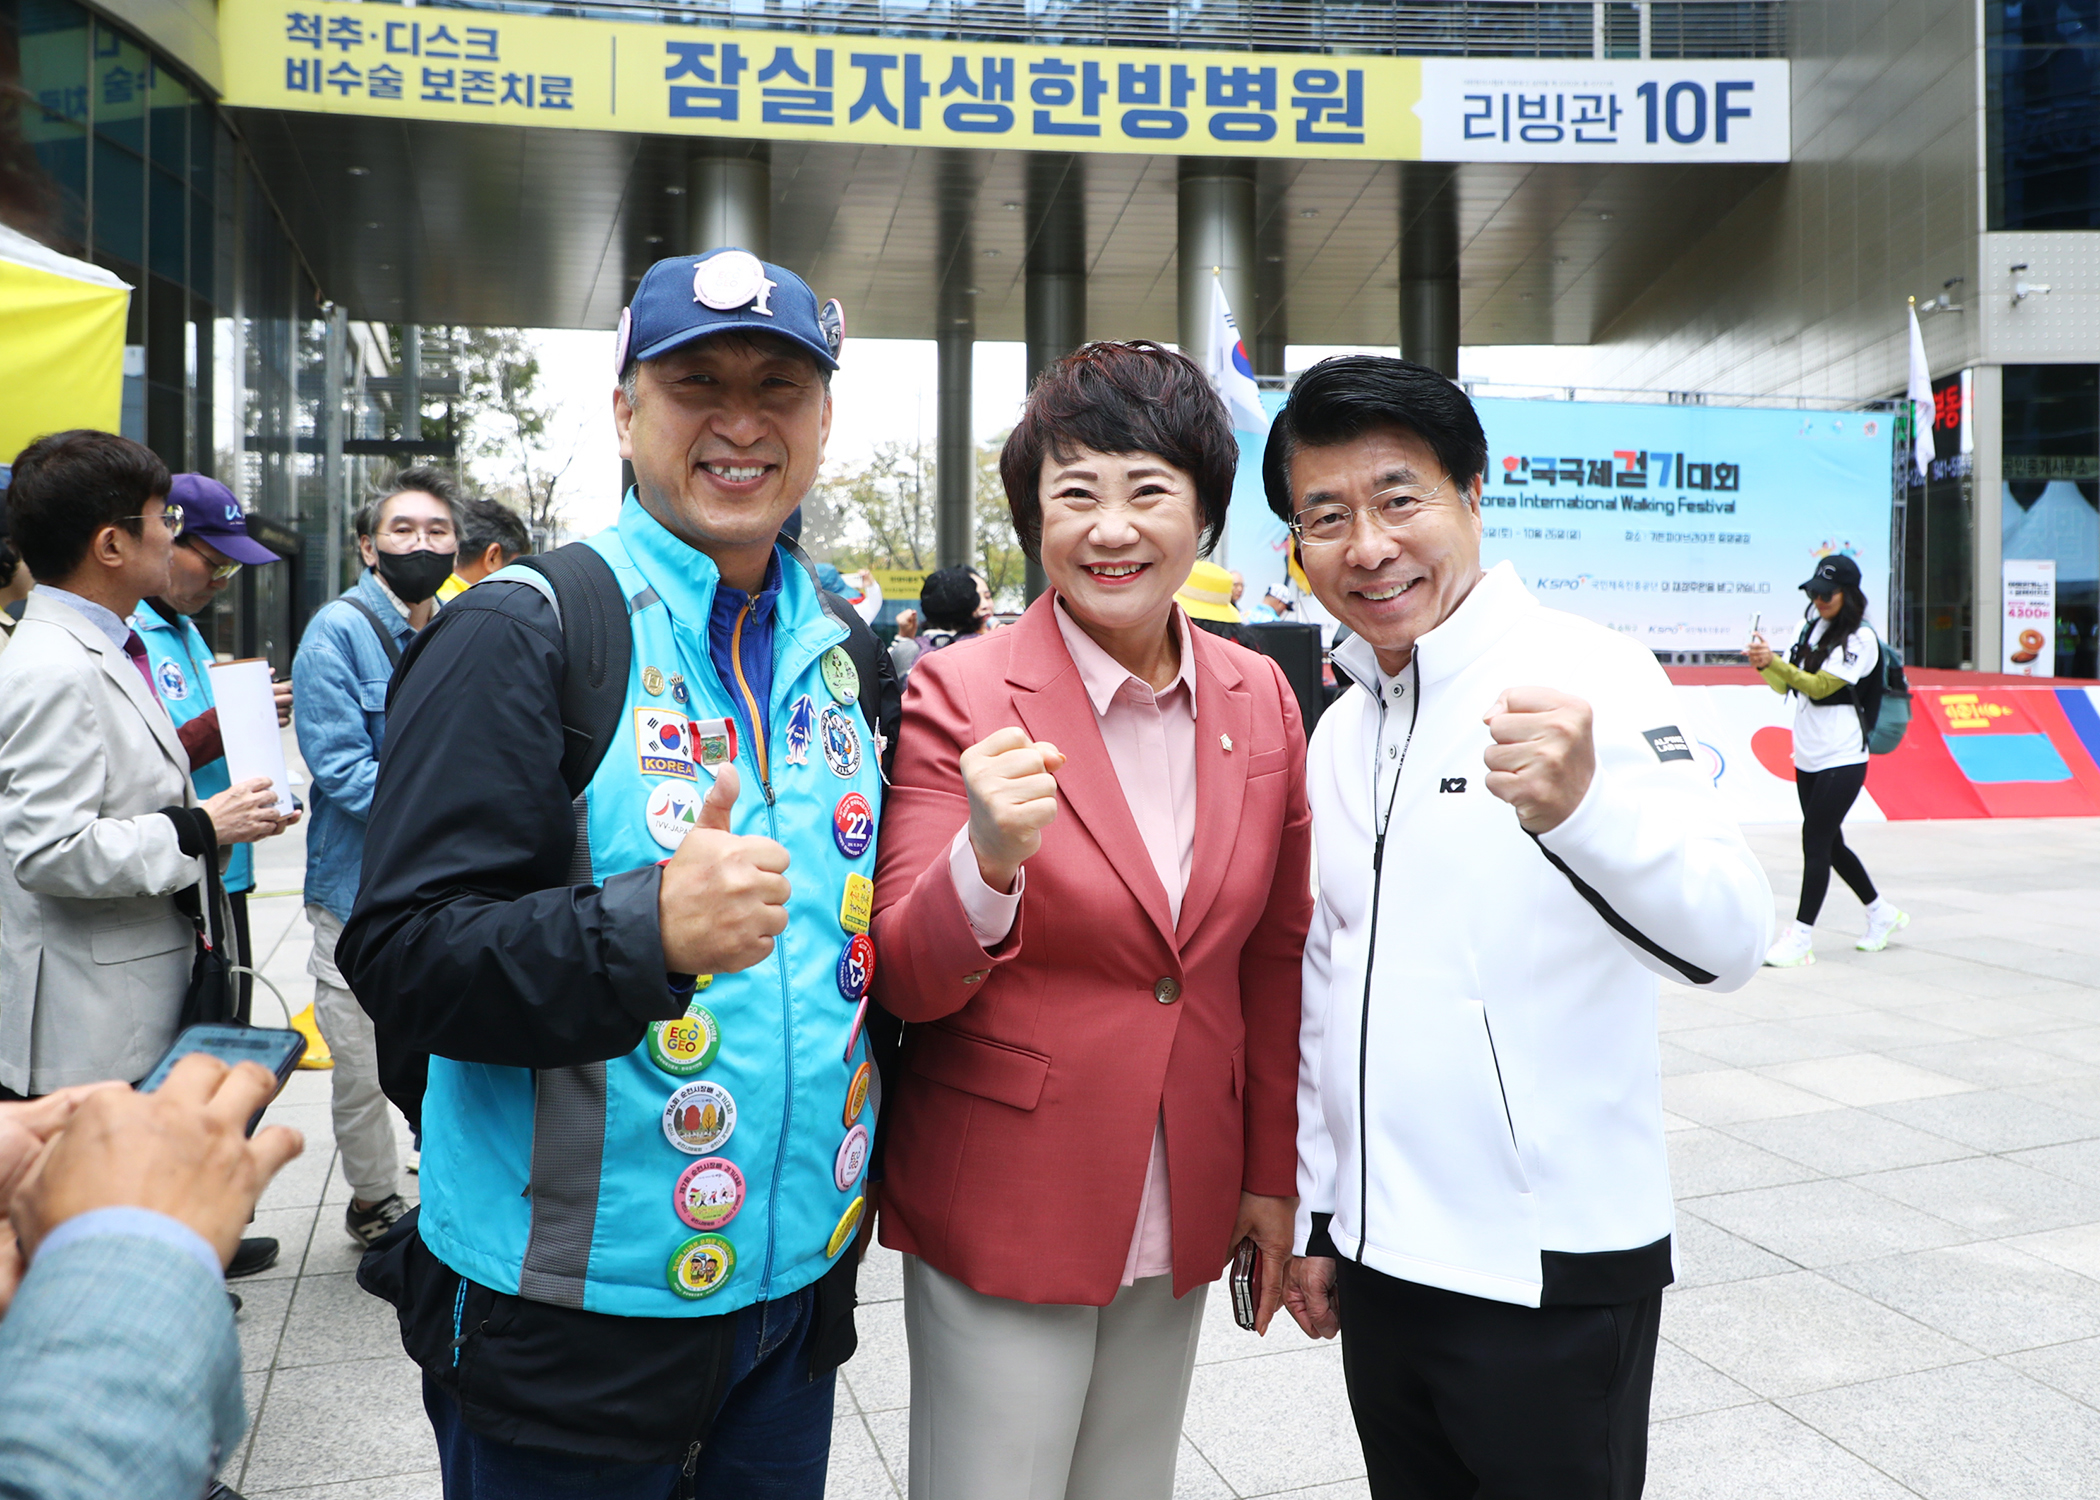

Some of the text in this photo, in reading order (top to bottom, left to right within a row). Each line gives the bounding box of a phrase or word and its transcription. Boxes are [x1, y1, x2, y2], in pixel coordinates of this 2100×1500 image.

[287, 12, 498, 61] 척추·디스크
[287, 58, 573, 109] 비수술 보존치료
[665, 41, 1366, 144] 잠실자생한방병원
[1463, 80, 1755, 144] 리빙관 10F
[1502, 450, 1739, 491] 한국국제걷기대회
[1480, 492, 1736, 516] orea International Walking Festival
[1482, 526, 1512, 539] 5일(토)
[1537, 577, 1580, 590] KSPO
[645, 757, 693, 775] KOREA
[1440, 778, 1467, 793] K2
[656, 820, 691, 835] IVV-JAPA
[845, 812, 867, 839] 22
[848, 951, 866, 988] 23
[667, 1038, 696, 1053] GEO
[670, 1026, 699, 1041] ECO
[666, 1085, 734, 1116] 제6회 순천시장배 걷기대회
[679, 1162, 742, 1194] 제7회 순천시장배 걷기대회
